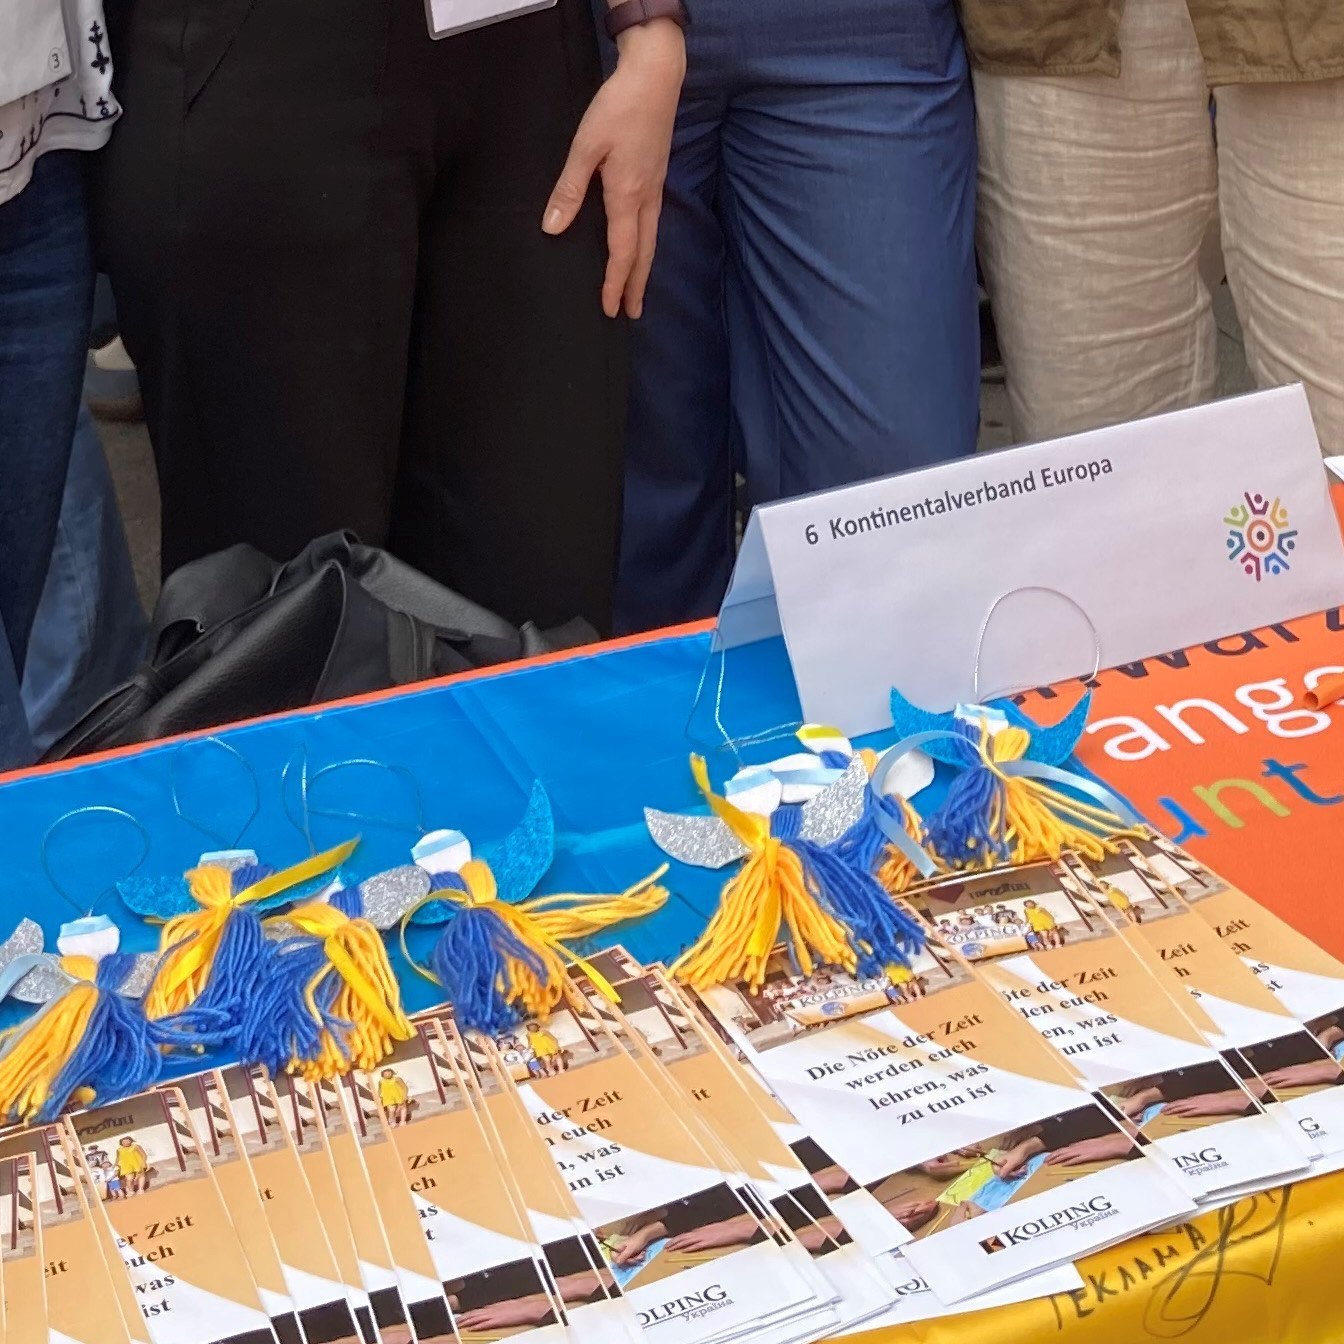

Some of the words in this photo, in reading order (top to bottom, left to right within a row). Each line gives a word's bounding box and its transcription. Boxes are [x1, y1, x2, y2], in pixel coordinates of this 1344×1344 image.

[50, 53, 61, 70] 3
[804, 523, 819, 546] 6
[829, 471, 1037, 542] Kontinentalverband
[1041, 456, 1113, 494] Europa
[1036, 978, 1069, 994] der
[1074, 967, 1118, 985] Zeit
[1059, 989, 1109, 1009] euch
[1076, 1013, 1118, 1030] was
[807, 1059, 846, 1083] Die
[846, 1040, 899, 1069] Nöte
[902, 1028, 936, 1049] der
[939, 1011, 985, 1036] Zeit
[1093, 1031, 1122, 1047] ist
[845, 1058, 926, 1092] werden
[927, 1037, 978, 1064] euch
[867, 1074, 950, 1112] lehren,
[951, 1059, 990, 1084] was
[536, 1106, 572, 1127] der
[576, 1089, 623, 1114] Zeit
[896, 1107, 924, 1126] zu
[926, 1093, 966, 1116] tun
[968, 1079, 997, 1103] ist
[560, 1117, 613, 1142] euch
[407, 1147, 456, 1170] Zeit
[577, 1142, 622, 1164] was
[594, 1164, 626, 1183] ist
[145, 1212, 196, 1241] Zeit
[1005, 1195, 1113, 1246] KOLPING
[1069, 1206, 1120, 1233] Україна
[141, 1297, 173, 1320] ist
[681, 1297, 735, 1322] Україна
